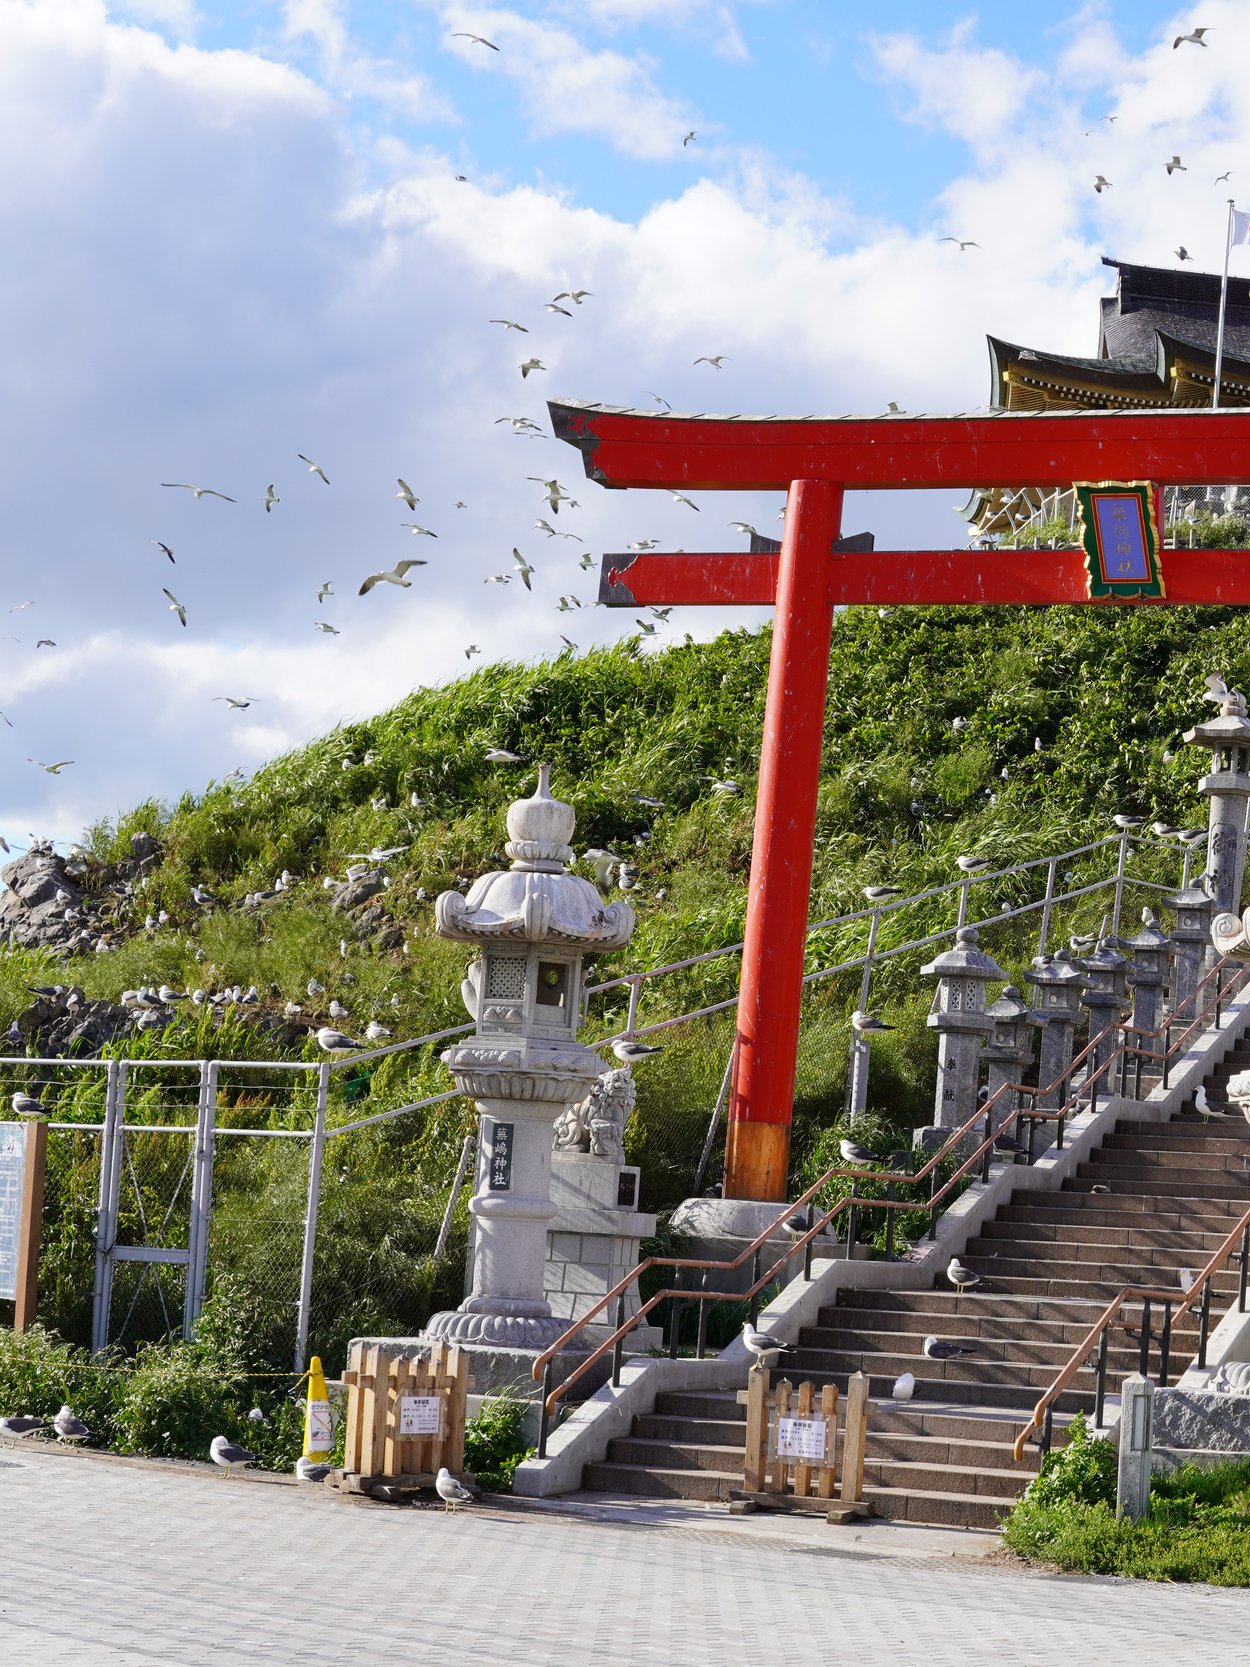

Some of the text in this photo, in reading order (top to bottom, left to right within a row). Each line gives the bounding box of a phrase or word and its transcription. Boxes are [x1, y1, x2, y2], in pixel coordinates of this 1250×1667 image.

[943, 1057, 957, 1102] 奉献
[492, 1126, 508, 1186] 蕪嶋神社
